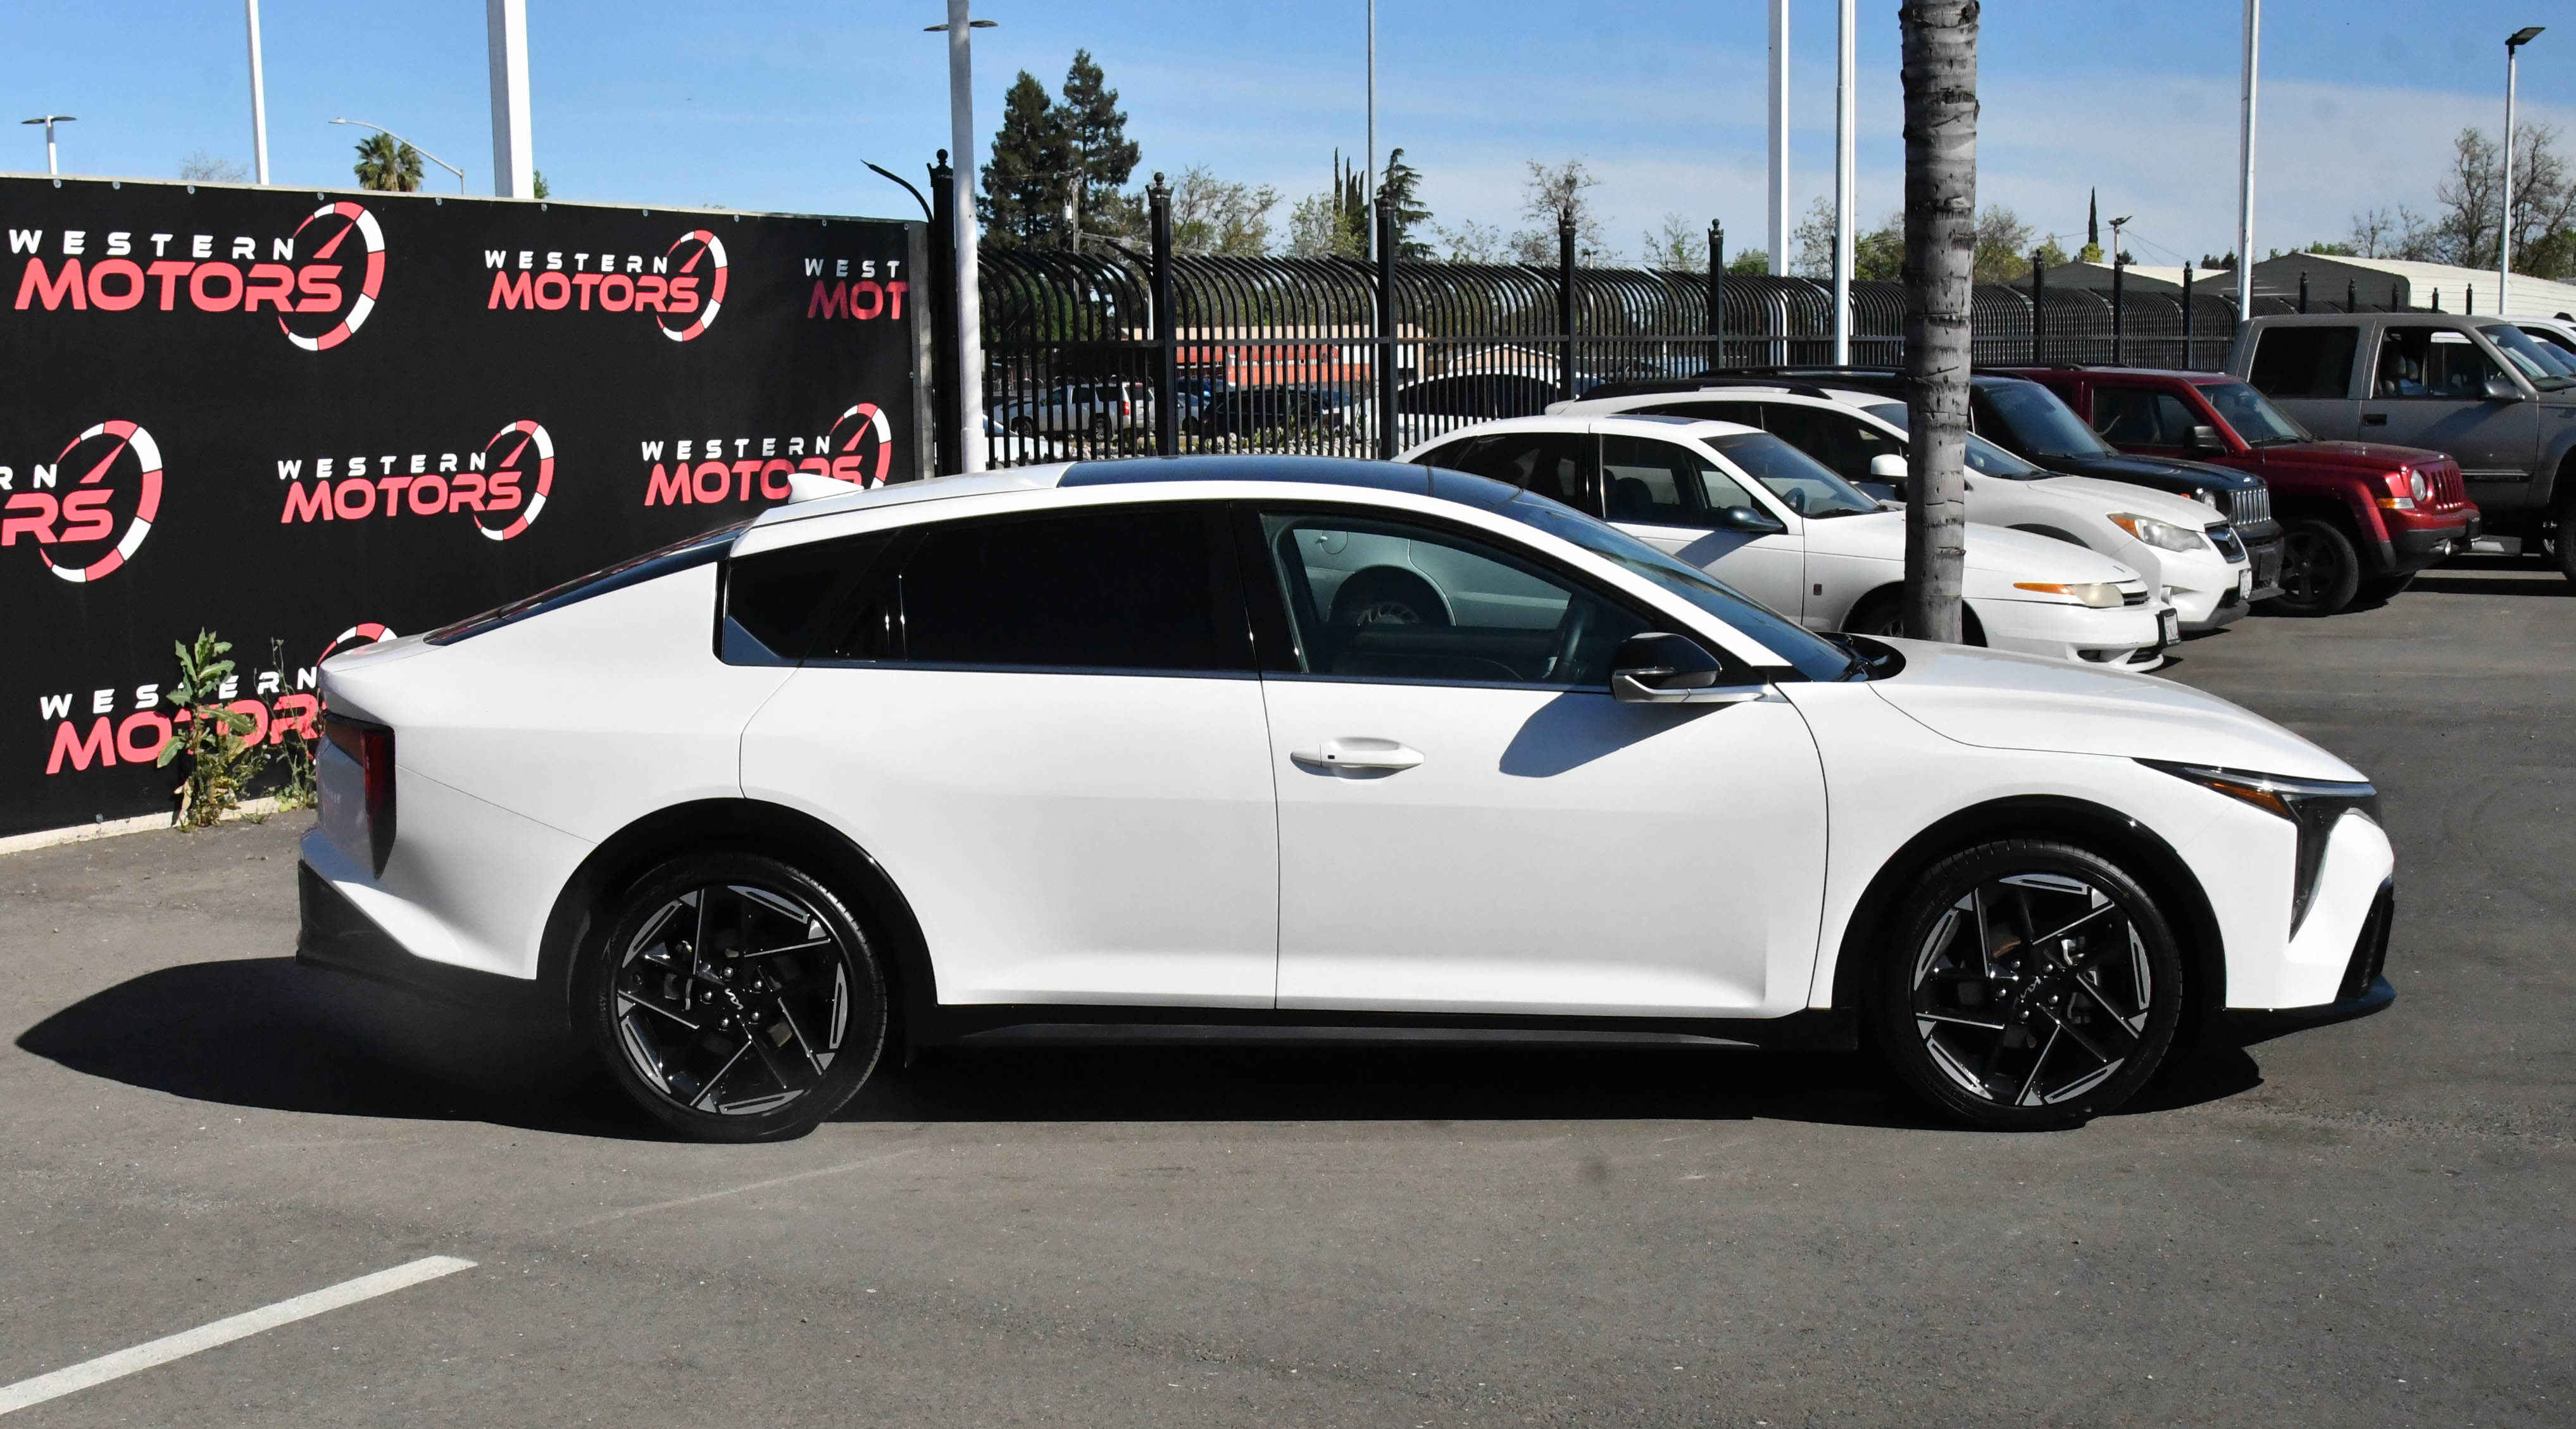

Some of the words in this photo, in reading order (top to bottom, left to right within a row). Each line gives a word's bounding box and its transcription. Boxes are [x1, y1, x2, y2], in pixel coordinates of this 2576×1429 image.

[9, 229, 294, 261] WESTERN
[485, 250, 668, 274] WESTERN
[14, 256, 343, 312] MOTORS
[804, 258, 901, 279] WEST
[487, 270, 699, 313] MOTORS
[807, 279, 910, 320] MOT
[277, 452, 486, 480] WESTERN
[641, 436, 830, 462] WESTERN
[280, 470, 522, 524] MOTORS
[40, 666, 318, 720] WESERN
